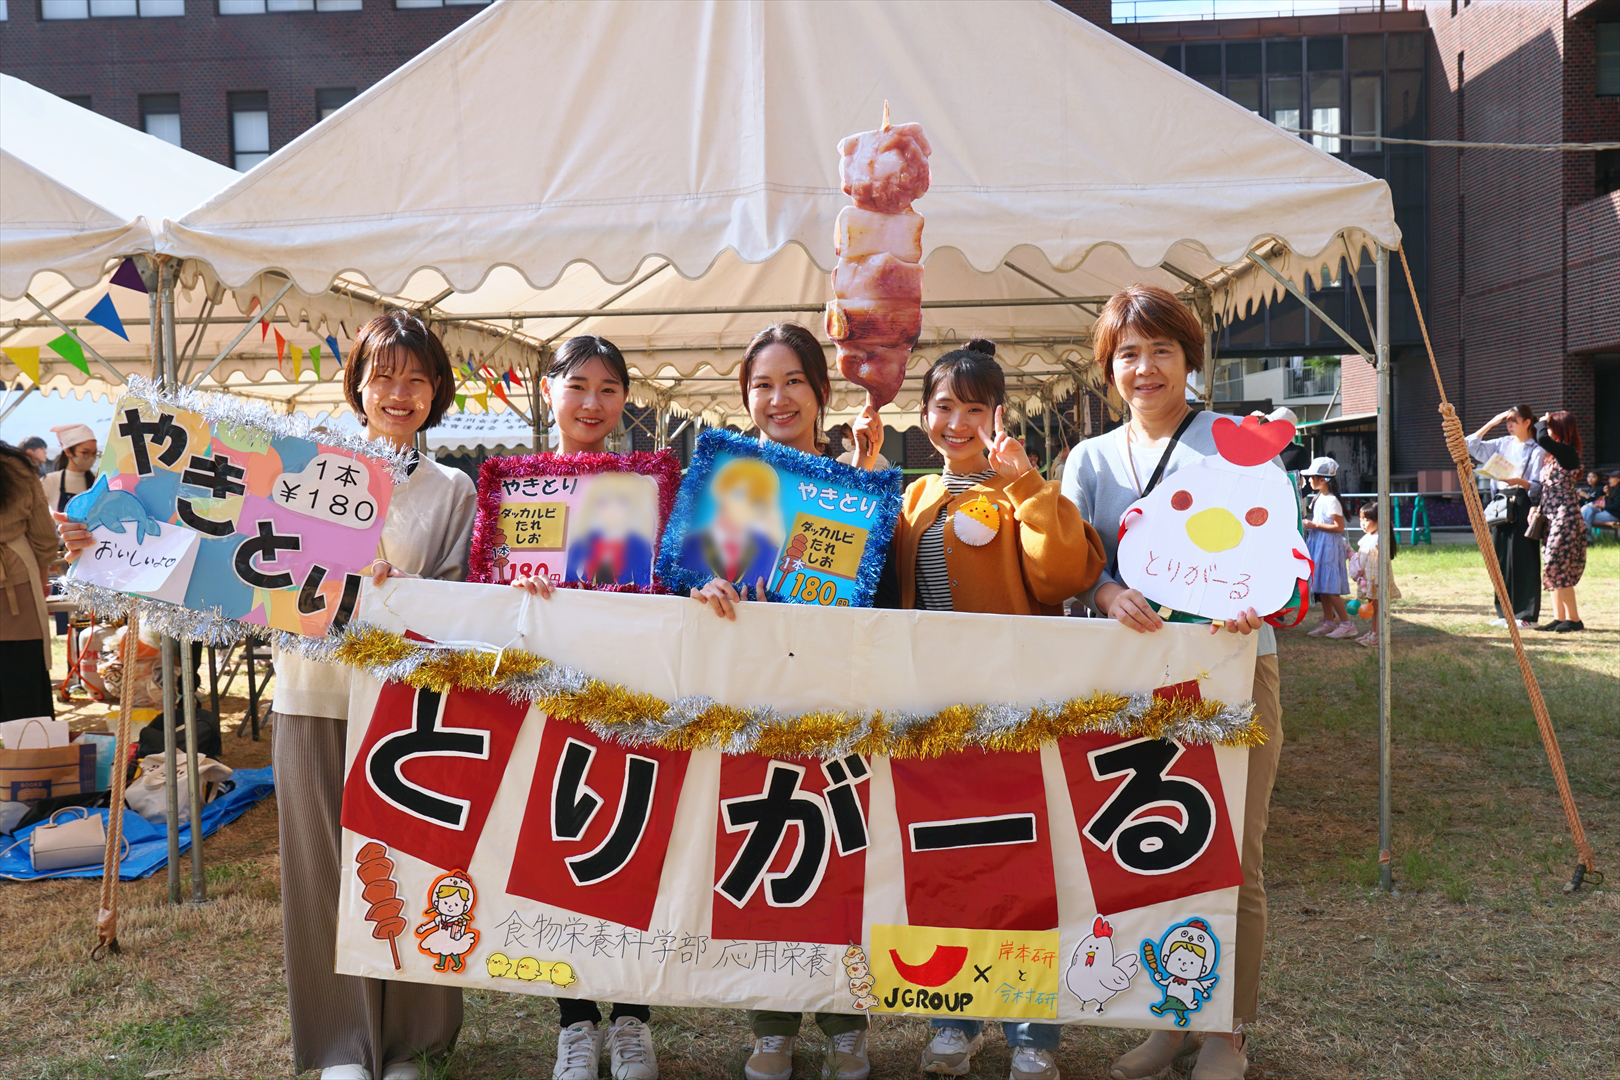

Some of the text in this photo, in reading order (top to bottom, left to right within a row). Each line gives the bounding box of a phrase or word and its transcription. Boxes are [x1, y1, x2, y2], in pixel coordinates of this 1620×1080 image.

[316, 459, 361, 487] 1本
[501, 477, 578, 497] やきとり
[797, 481, 878, 519] やきとり
[280, 480, 375, 522] ¥180
[500, 507, 557, 519] ダッカルビ
[118, 407, 363, 629] やきとり
[515, 520, 542, 532] たれ
[515, 533, 542, 545] しお
[801, 521, 855, 545] ダッカルビ
[492, 545, 511, 559] 1本
[810, 538, 836, 555] たれ
[783, 557, 806, 571] 1本
[808, 552, 834, 568] しお
[1145, 550, 1252, 600] とりがーる
[365, 687, 1216, 908] とりがーる
[495, 910, 708, 966] 食物栄養科学部
[998, 940, 1058, 969] 岸本研
[994, 982, 1058, 1011] 今村研
